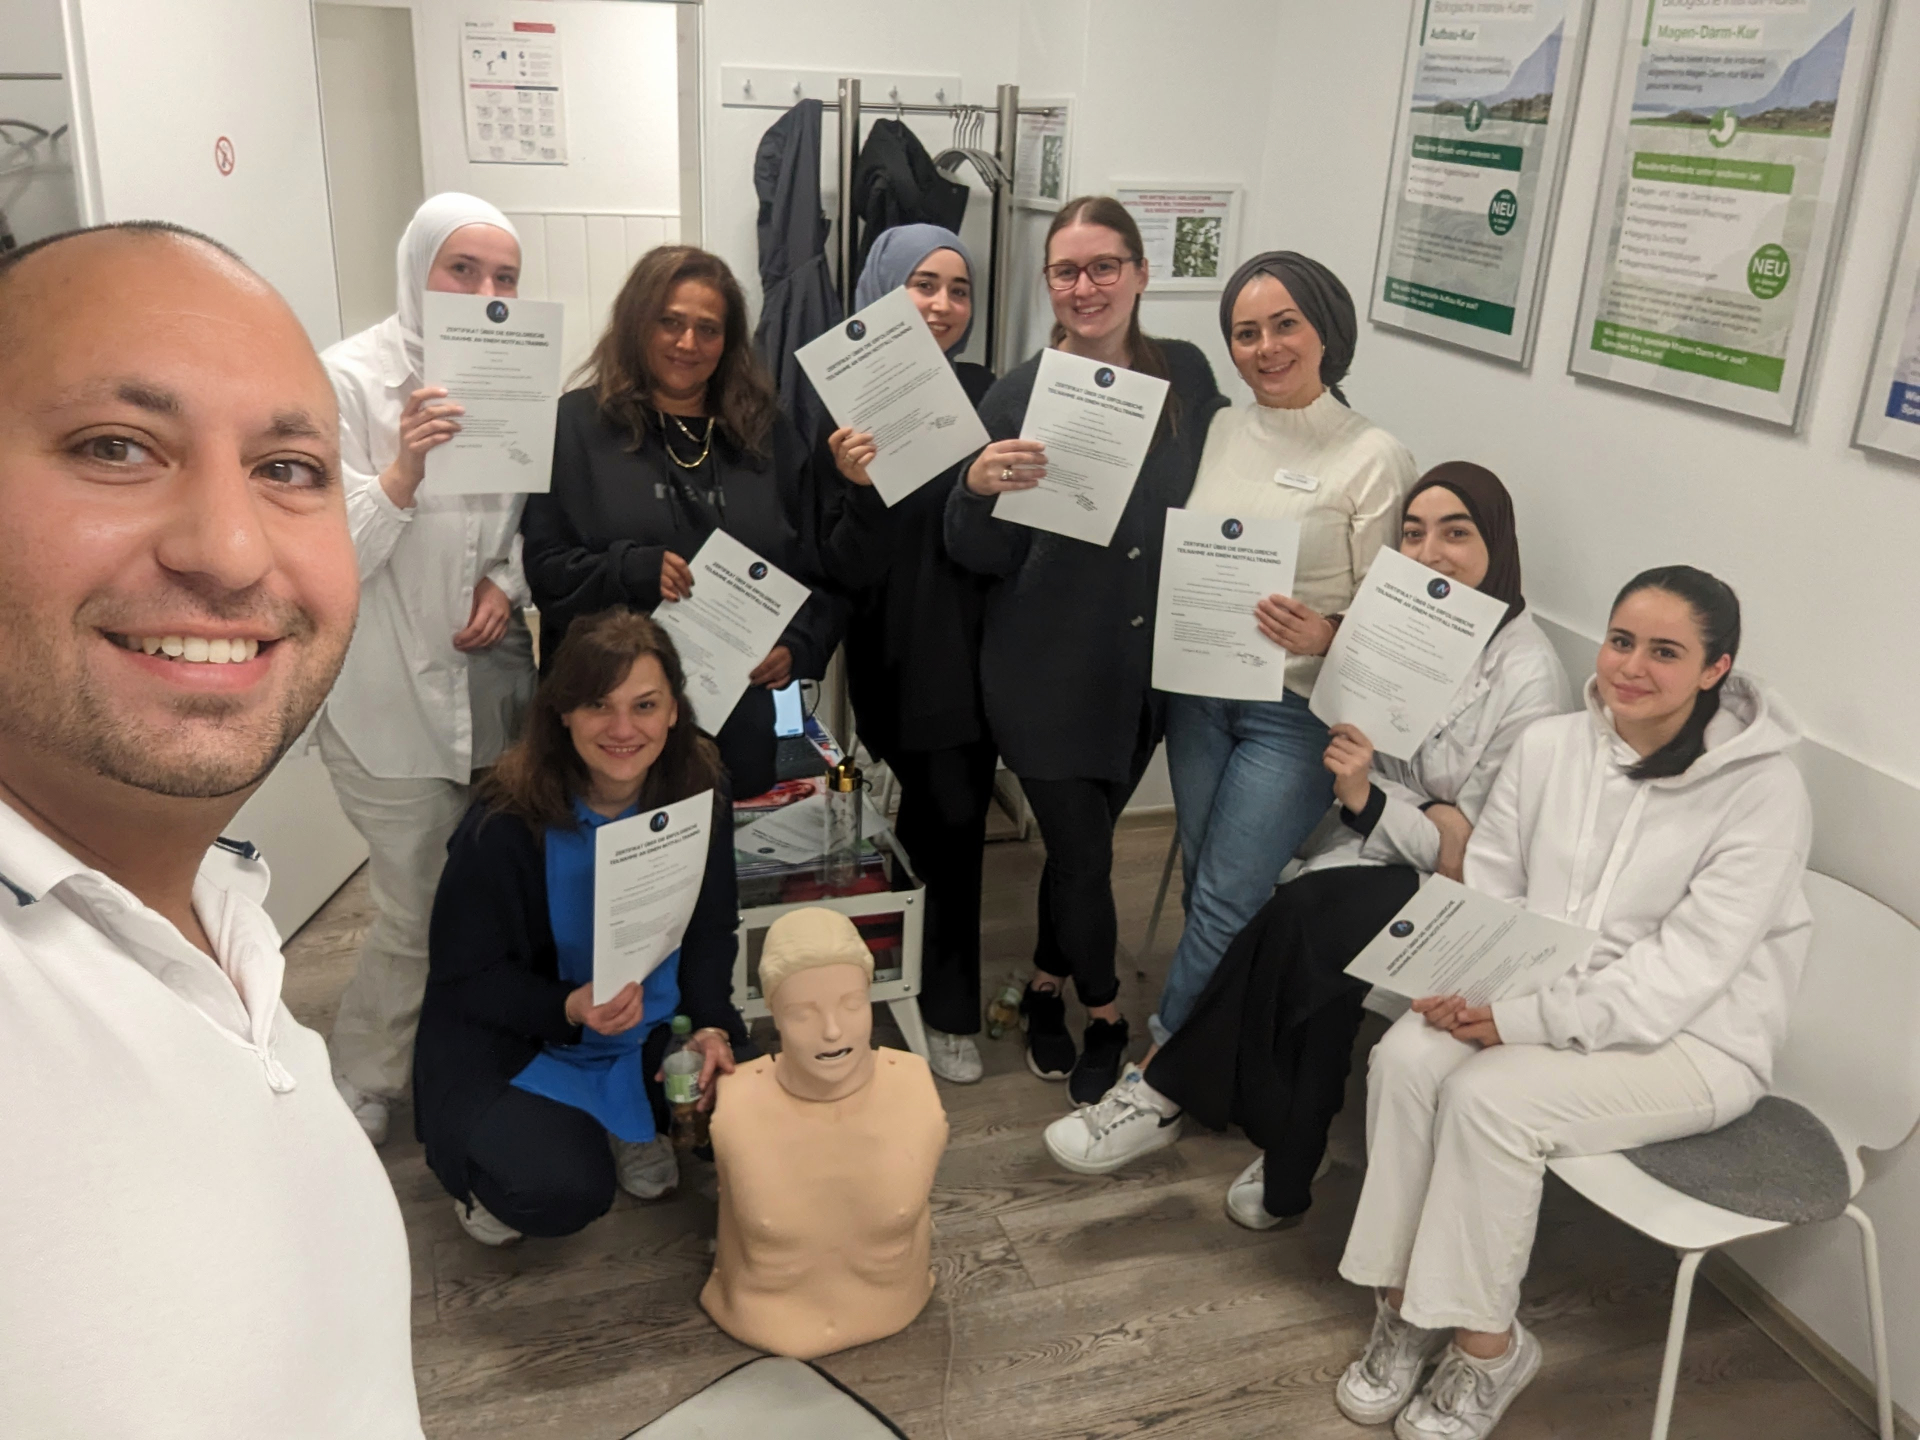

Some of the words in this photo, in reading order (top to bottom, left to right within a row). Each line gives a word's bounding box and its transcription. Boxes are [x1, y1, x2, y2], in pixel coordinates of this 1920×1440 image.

[1657, 25, 1760, 41] Magen-Darm-Kur
[1491, 201, 1516, 217] NEU
[1752, 258, 1788, 277] NEU
[1183, 540, 1211, 548] ZERTIFIKAT
[1383, 582, 1412, 598] ZERTIFIKAT
[1412, 597, 1426, 606] ÜBER
[1426, 603, 1435, 611] DIE
